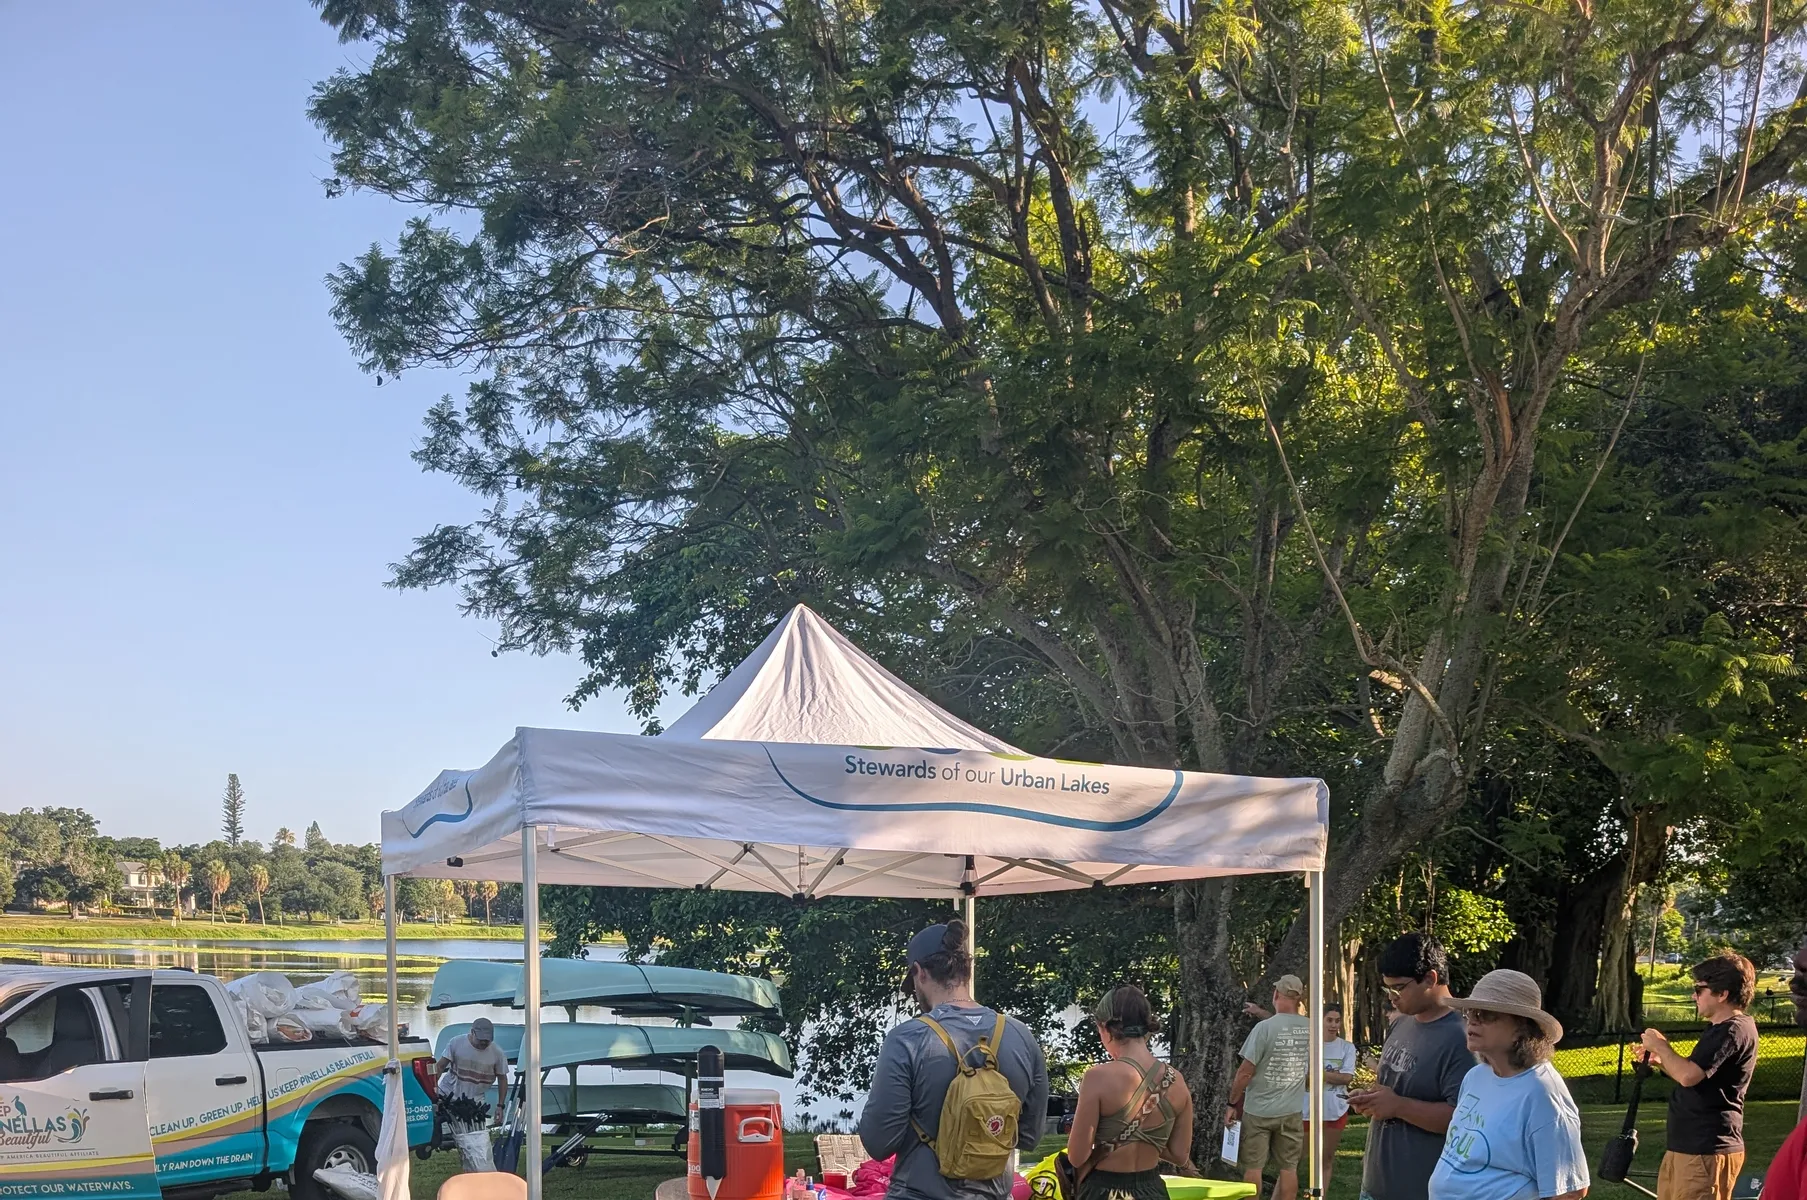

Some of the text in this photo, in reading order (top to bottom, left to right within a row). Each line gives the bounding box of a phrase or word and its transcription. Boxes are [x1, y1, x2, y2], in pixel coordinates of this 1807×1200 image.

[845, 755, 1110, 795] Stewards of our Urban Lakes
[149, 1120, 180, 1136] CLEAN
[182, 1116, 198, 1128] UP,
[199, 1106, 229, 1123] GREEN
[230, 1102, 246, 1114] UP,
[267, 1088, 279, 1099] US
[279, 1079, 299, 1095] KEEP
[300, 1064, 336, 1086] PINELLAS
[335, 1049, 375, 1070] BEAUTIFUL!
[0, 1116, 67, 1133] NELLAS
[169, 1161, 188, 1171] RAIN
[189, 1157, 214, 1169] DOWN
[216, 1156, 229, 1165] THE
[231, 1153, 254, 1163] DRAIN
[41, 1183, 65, 1193] OUR
[66, 1180, 134, 1192] WATERWAYS.
